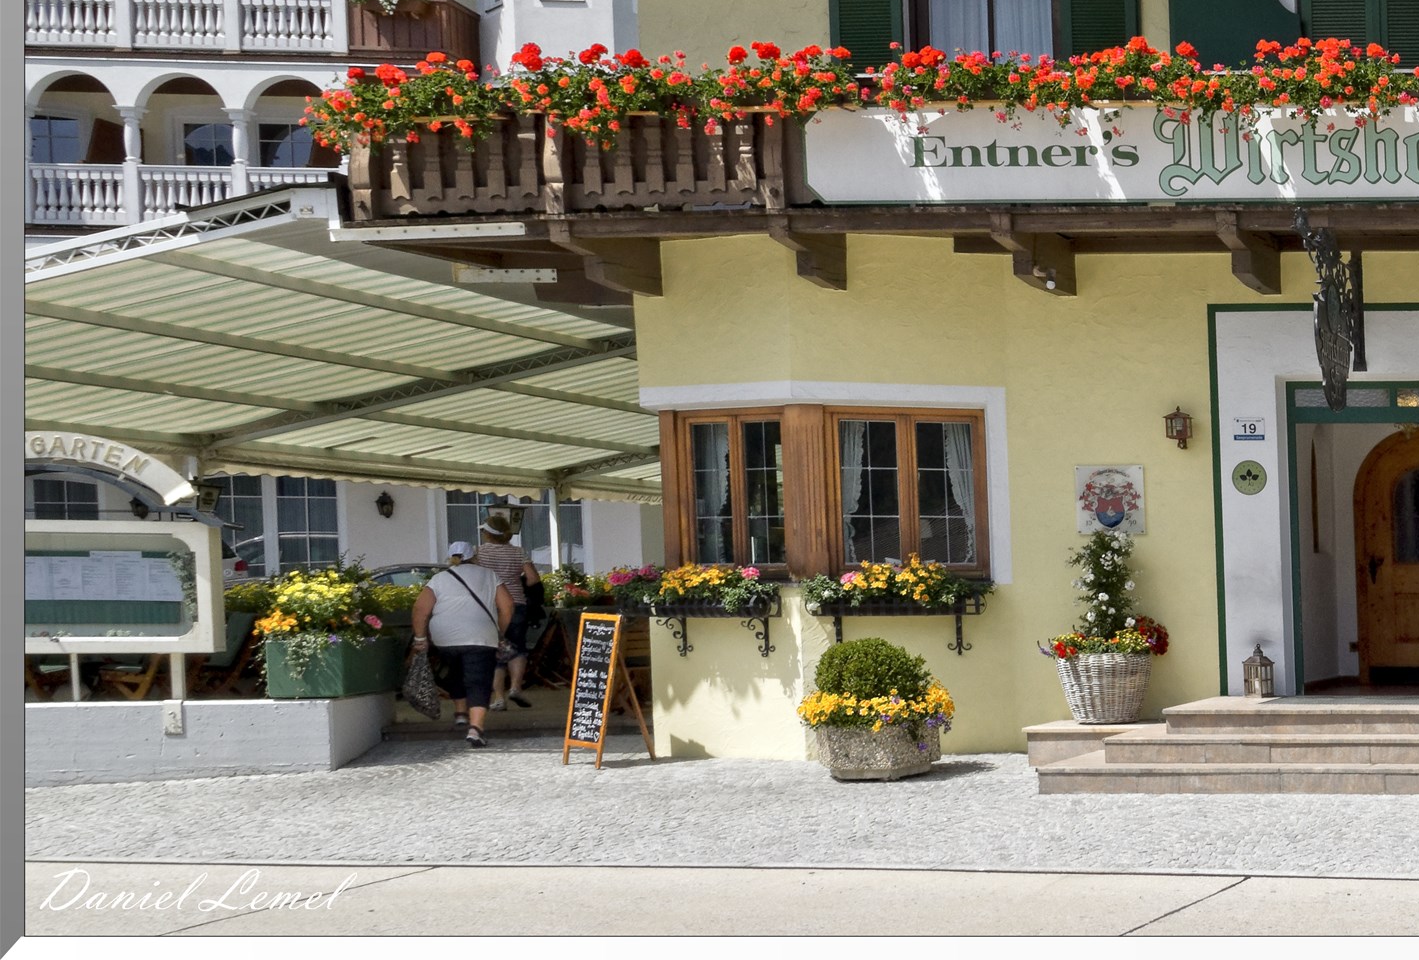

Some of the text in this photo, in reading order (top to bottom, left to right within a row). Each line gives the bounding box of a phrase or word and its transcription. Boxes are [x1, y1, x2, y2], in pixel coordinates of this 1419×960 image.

[909, 131, 1140, 168] Entner's
[1241, 423, 1257, 434] 19
[30, 435, 151, 474] GARTEN
